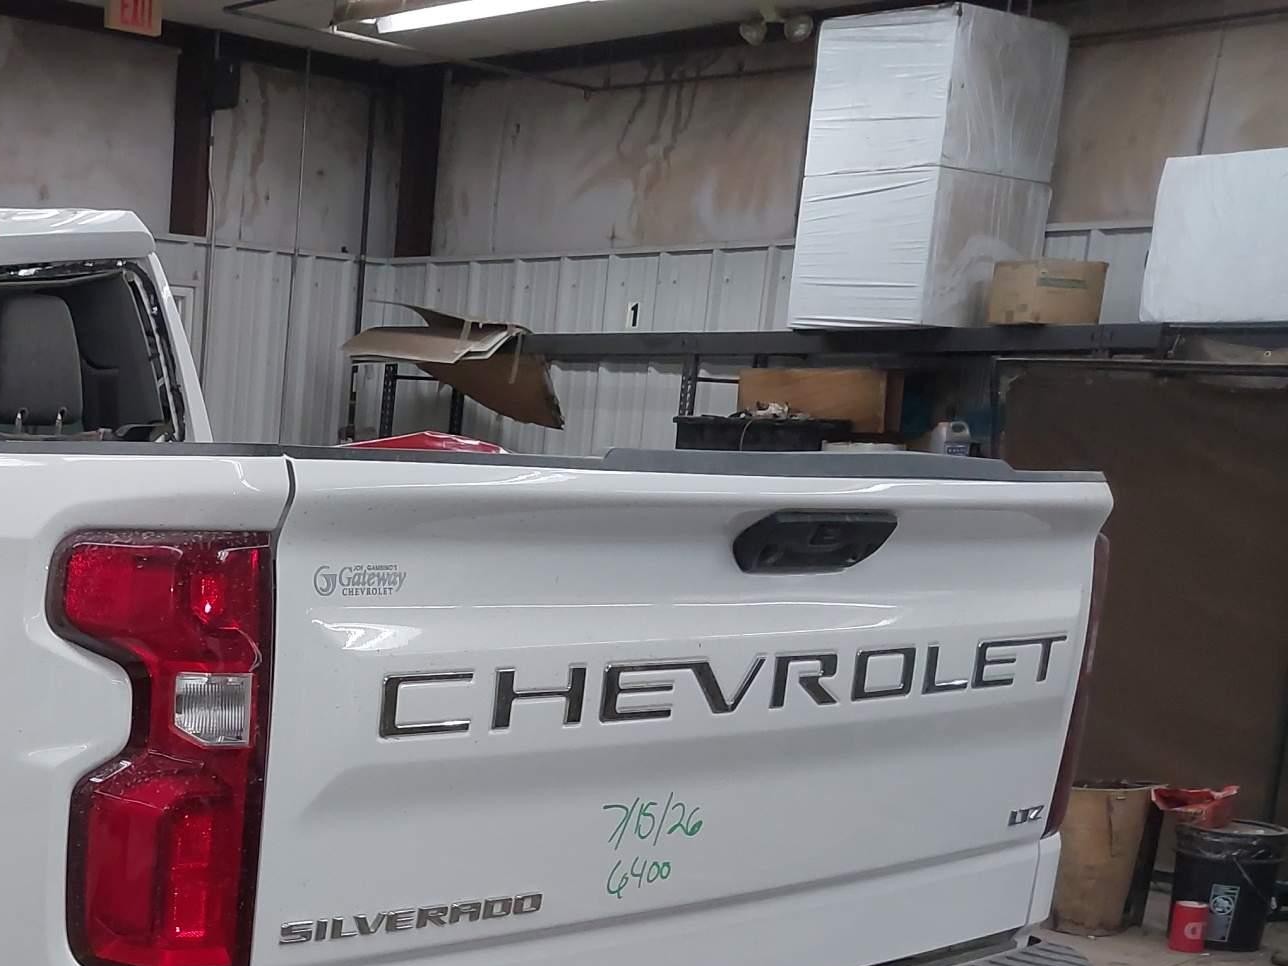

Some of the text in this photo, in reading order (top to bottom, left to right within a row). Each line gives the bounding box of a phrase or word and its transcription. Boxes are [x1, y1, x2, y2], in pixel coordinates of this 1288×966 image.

[631, 303, 639, 327] 1
[339, 566, 407, 592] Gateway
[342, 587, 394, 596] CHEVROLET
[378, 635, 1067, 740] CHEVROLET
[603, 792, 703, 850] 7/15/26
[1008, 805, 1044, 827] LTZ
[607, 857, 671, 899] 6400
[278, 892, 543, 945] SILVERADO
